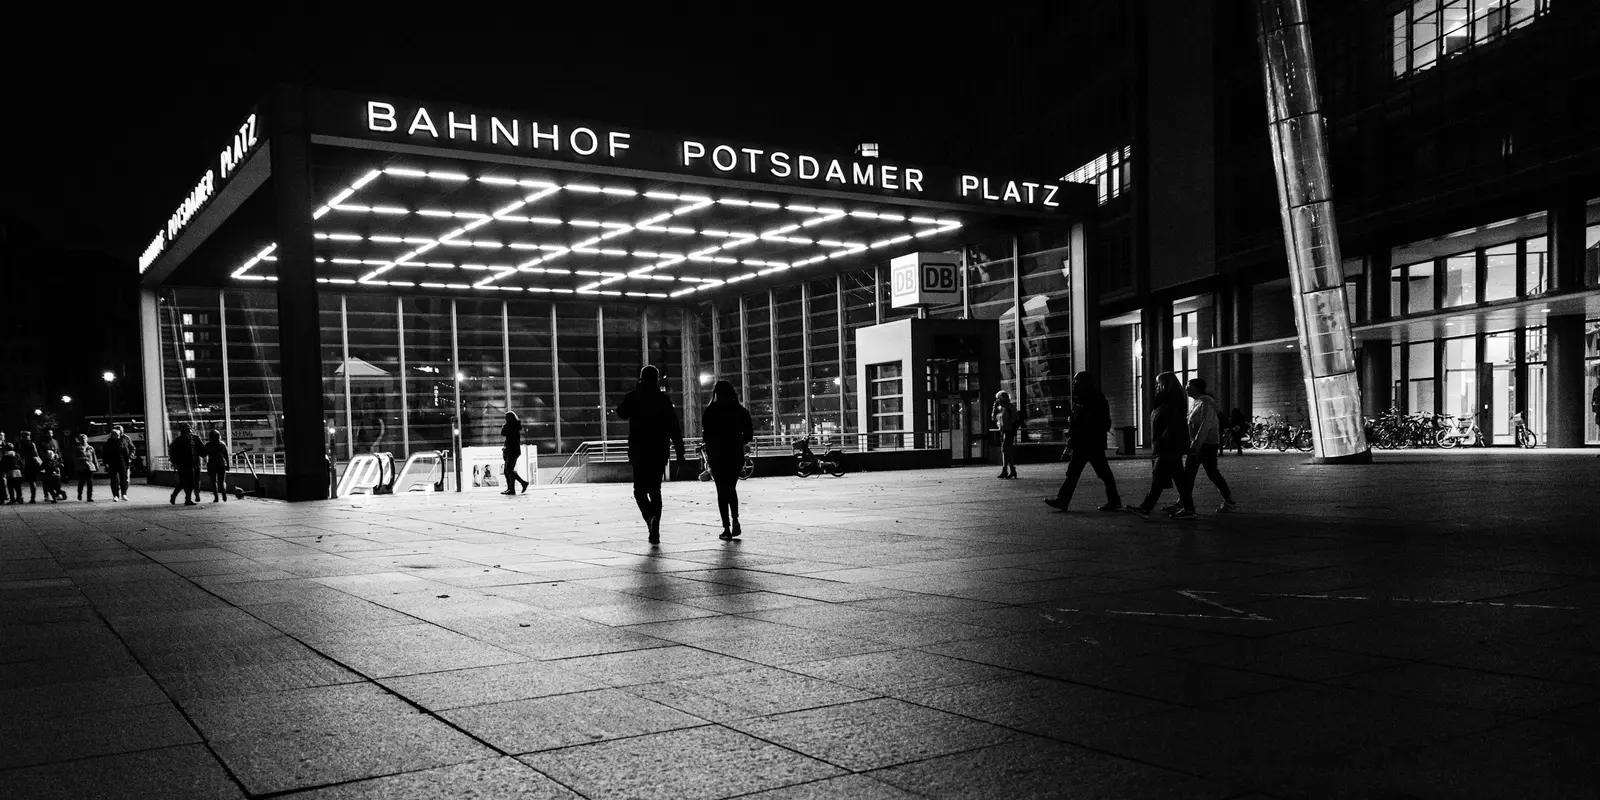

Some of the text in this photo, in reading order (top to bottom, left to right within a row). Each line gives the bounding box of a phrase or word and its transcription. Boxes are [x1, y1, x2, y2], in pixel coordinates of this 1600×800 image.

[220, 113, 258, 179] PLATZ
[368, 101, 1060, 207] BAHNHOF POTSDAMER PLATZ
[896, 270, 914, 293] DB
[925, 268, 953, 288] DB
